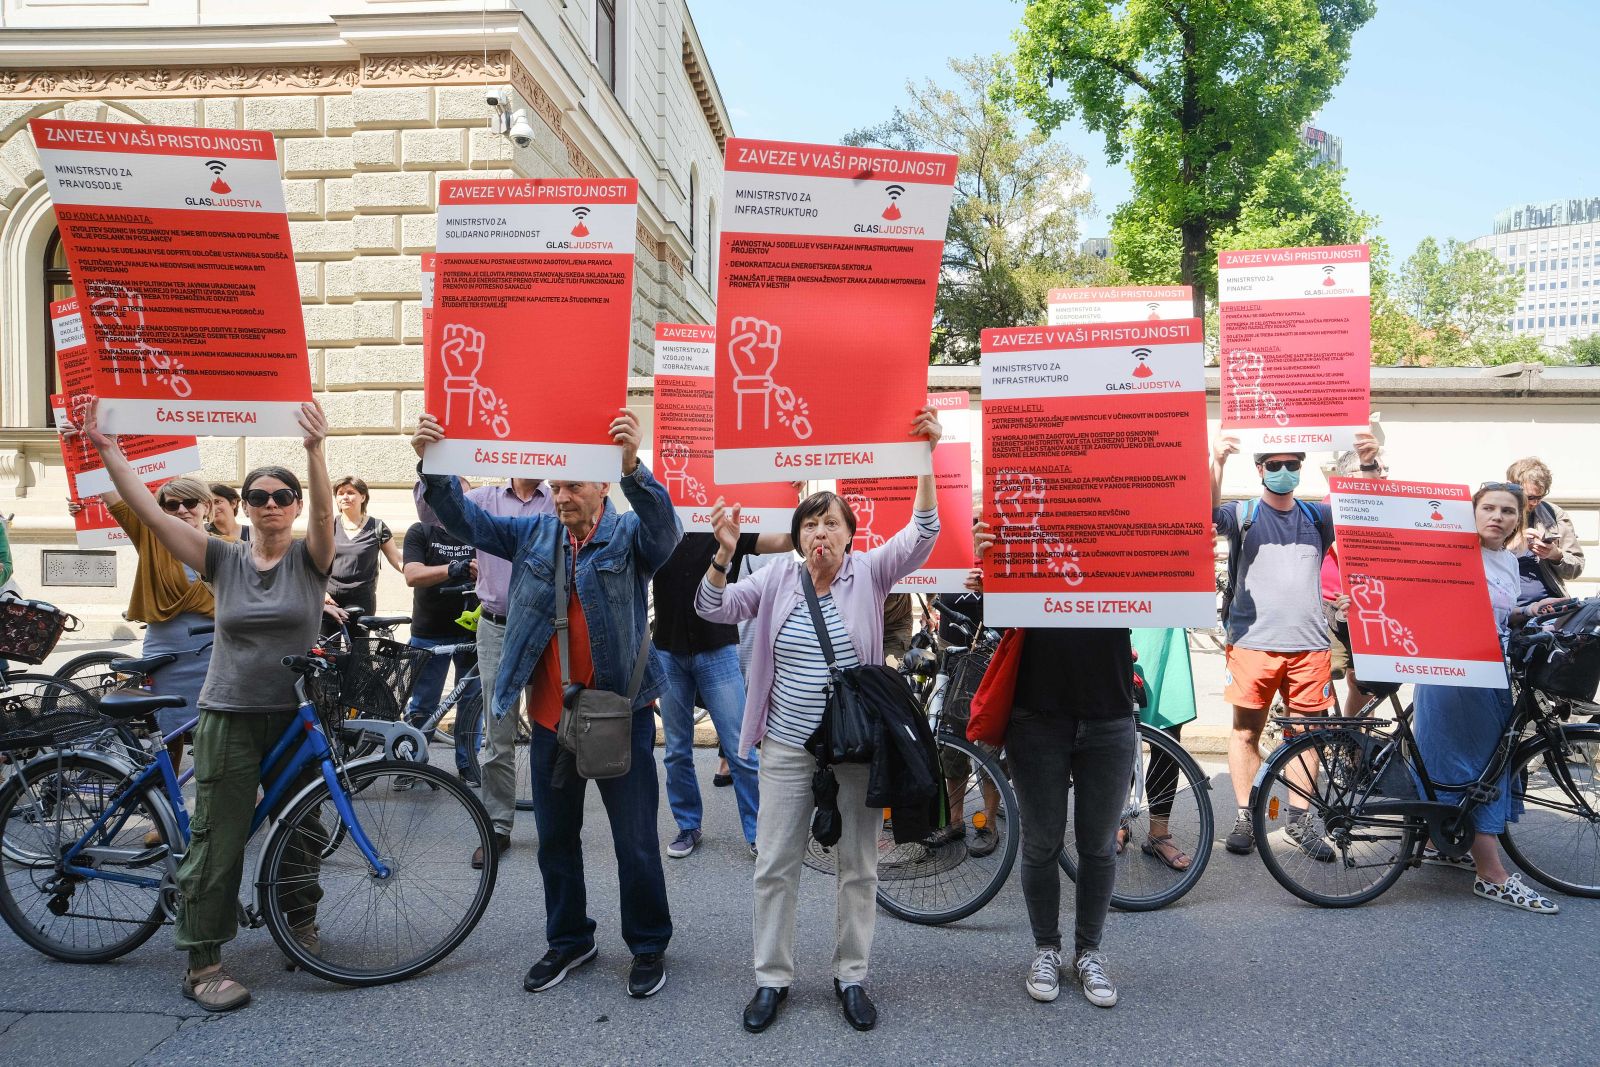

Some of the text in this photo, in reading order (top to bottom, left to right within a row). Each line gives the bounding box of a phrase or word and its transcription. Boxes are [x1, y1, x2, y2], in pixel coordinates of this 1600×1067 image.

[44, 127, 263, 152] ZAVEZE V VAŠI PRISTOJNOSTI
[738, 148, 946, 177] ZAVEZE V VAŠI PRISTOJNOSTI
[55, 166, 133, 177] MINISTRSTVO ZA
[59, 180, 123, 190] PRAVOSODJE
[450, 183, 626, 198] ZAVEZE V VAŠI PRISTOJNOSTI
[735, 190, 811, 202] MINISTRSTVO ZA
[59, 212, 153, 224] DO KONCA MANDATA:
[734, 206, 818, 218] INFRASTRUKTURO
[1227, 250, 1362, 264] ZAVEZE V VAŠI PRISTOJNOSTI
[1099, 290, 1119, 299] VAŠI
[57, 301, 79, 314] ZAVE
[663, 328, 698, 338] ZAVEZE
[992, 326, 1190, 347] ZAVEZE V VAŠI PRISTOJNOSTI
[662, 362, 709, 371] IZOBRAŽEVANJE
[992, 364, 1048, 373] MINISTRSTVO
[992, 375, 1069, 385] INFRASTRUKTURO
[991, 405, 1020, 414] PRVEM
[1021, 404, 1043, 413] LETU:
[156, 408, 256, 423] ČAS SE IZTEKA!
[1264, 434, 1282, 443] ČAS
[475, 449, 566, 466] ČAS SE IZTEKA!
[775, 452, 874, 467] ČAS SE IZTEKA!
[137, 460, 166, 475] IZTEKA!
[986, 465, 1072, 475] DO KONCA MANDATA:
[1337, 482, 1463, 496] ZAVEZE V VAŠI PRISTOJNOSTI
[692, 514, 710, 522] ČAS
[108, 530, 121, 540] ČAS
[904, 576, 937, 585] IZTEKA!
[1044, 598, 1151, 613] ČAS SE IZTEKA!
[1396, 663, 1466, 676] ČAS SE IZTEKA!
